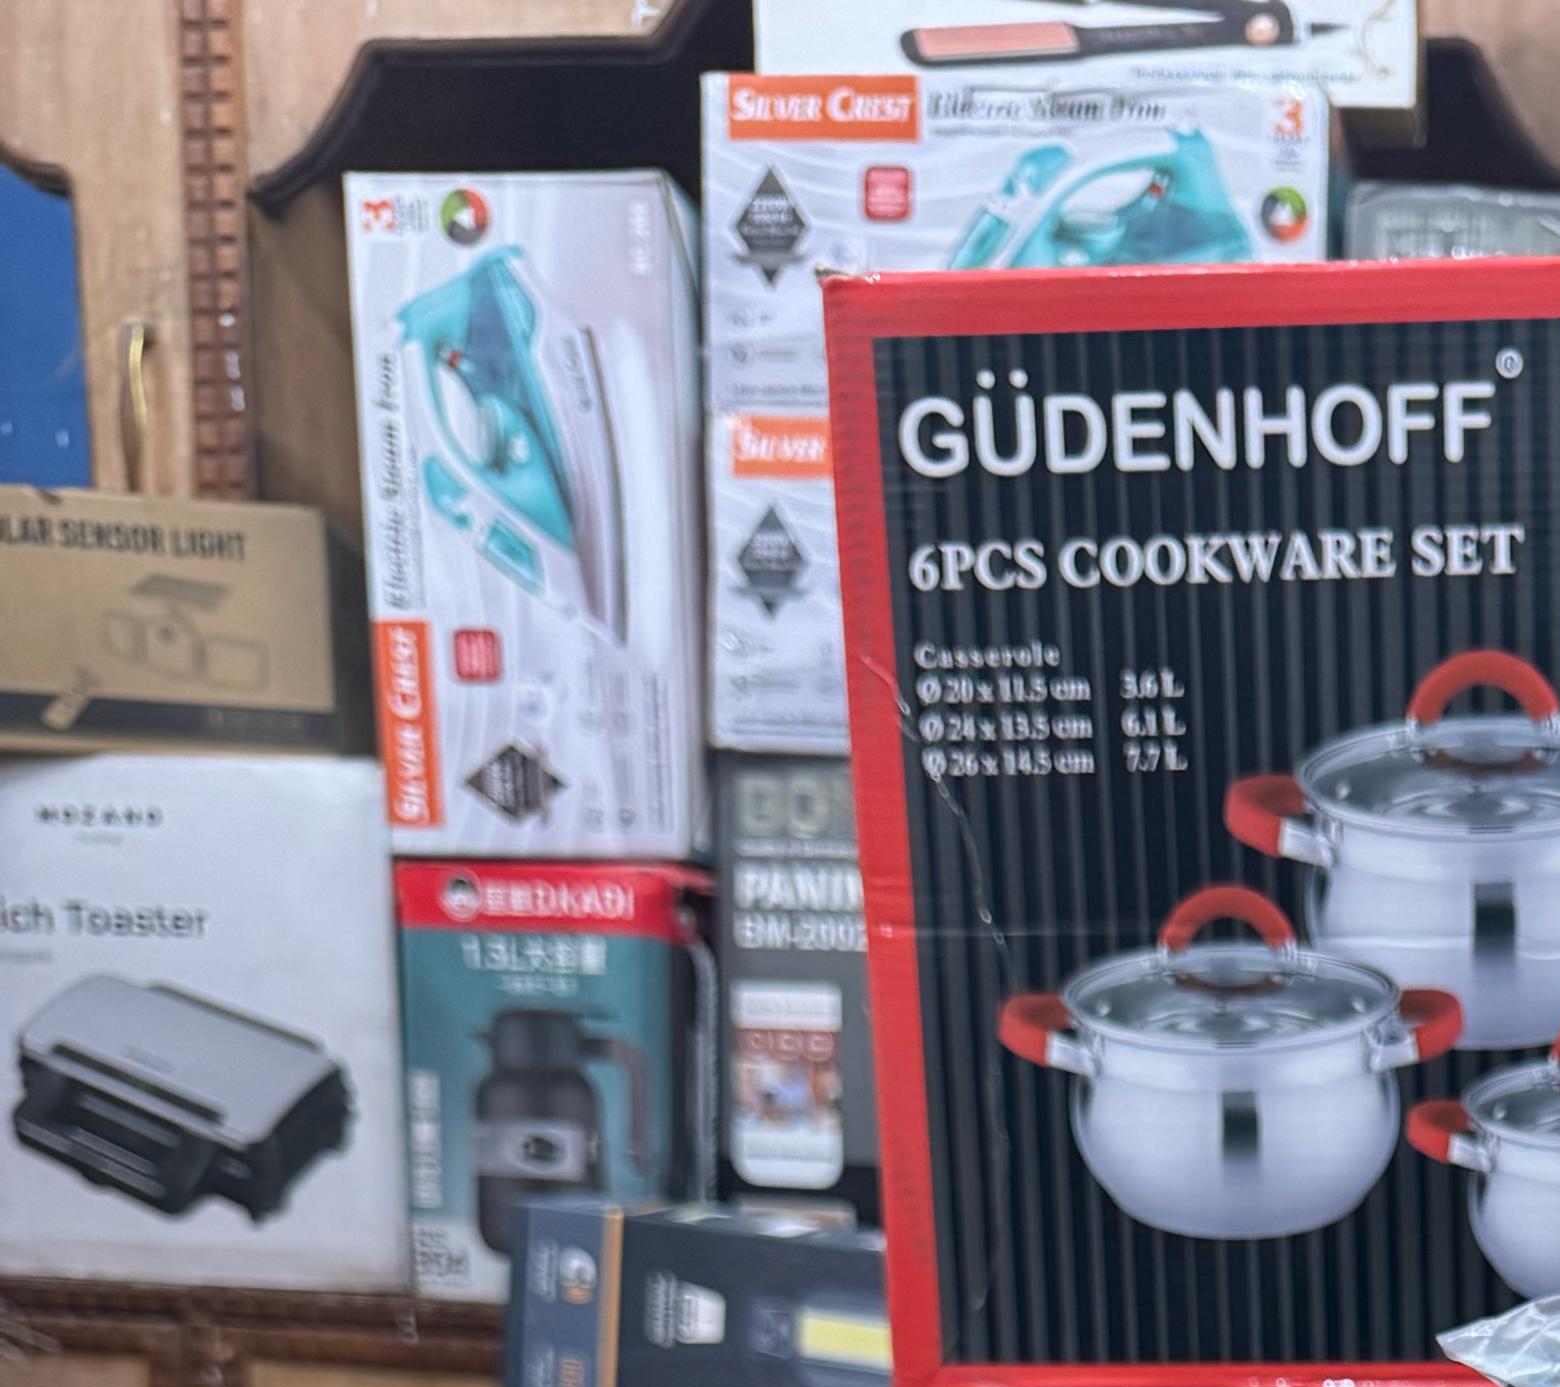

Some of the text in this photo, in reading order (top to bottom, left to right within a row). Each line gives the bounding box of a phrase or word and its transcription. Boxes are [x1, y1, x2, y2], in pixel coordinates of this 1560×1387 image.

[909, 525, 1524, 590] 6PCS COOKWARE SET
[914, 640, 1060, 669] Casserole
[61, 899, 206, 939] Toaster
